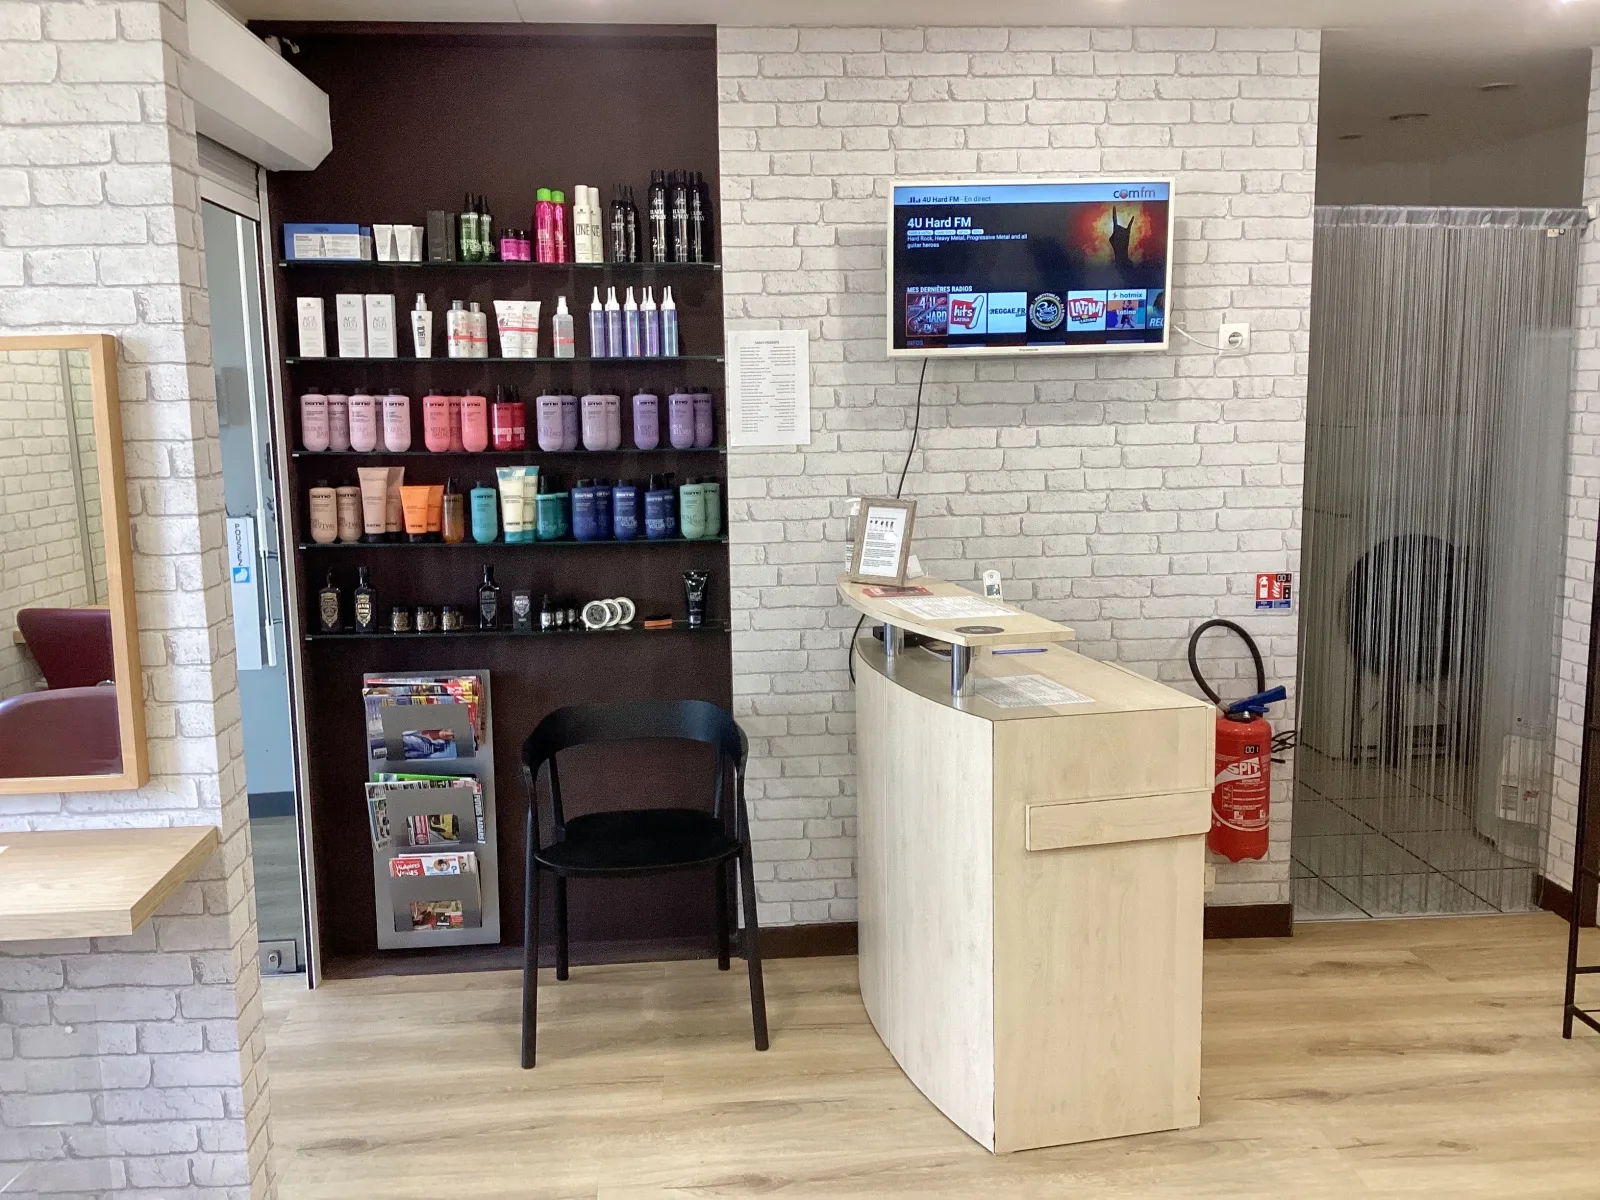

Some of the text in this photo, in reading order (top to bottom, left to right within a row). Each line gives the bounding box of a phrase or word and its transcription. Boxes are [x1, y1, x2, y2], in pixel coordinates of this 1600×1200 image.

[1113, 186, 1155, 199] comfm
[907, 217, 971, 228] 4U Hard FM
[954, 305, 972, 317] hits
[1070, 300, 1105, 317] LATINA
[926, 311, 947, 322] HARD
[235, 523, 243, 566] POUSSEZ
[1227, 762, 1260, 776] SPIT
